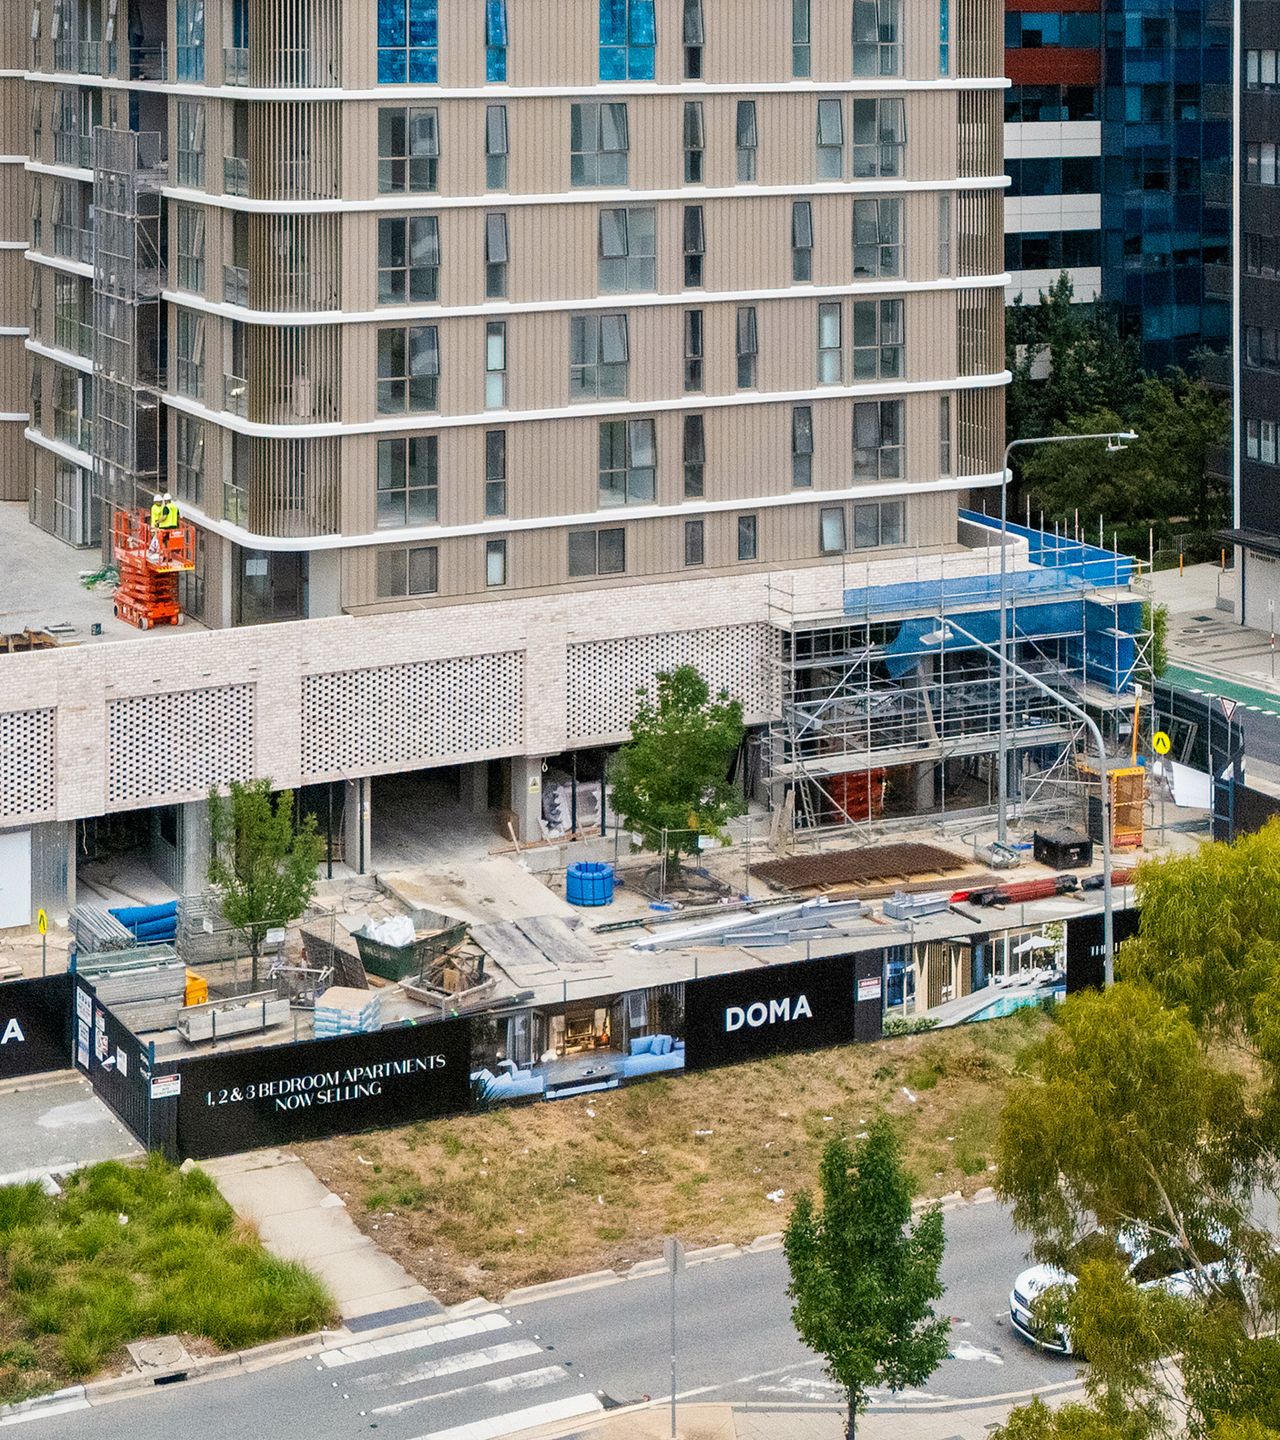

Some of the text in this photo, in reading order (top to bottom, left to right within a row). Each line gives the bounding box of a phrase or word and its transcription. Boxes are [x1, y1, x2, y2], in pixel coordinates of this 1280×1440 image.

[725, 994, 813, 1032] DOMA
[218, 1089, 228, 1104] 2
[230, 1086, 244, 1102] &
[246, 1084, 256, 1100] 3
[258, 1071, 340, 1098] BEDROOM
[342, 1053, 447, 1083] APARTMENTS
[275, 1081, 383, 1112] NOW SELLING
